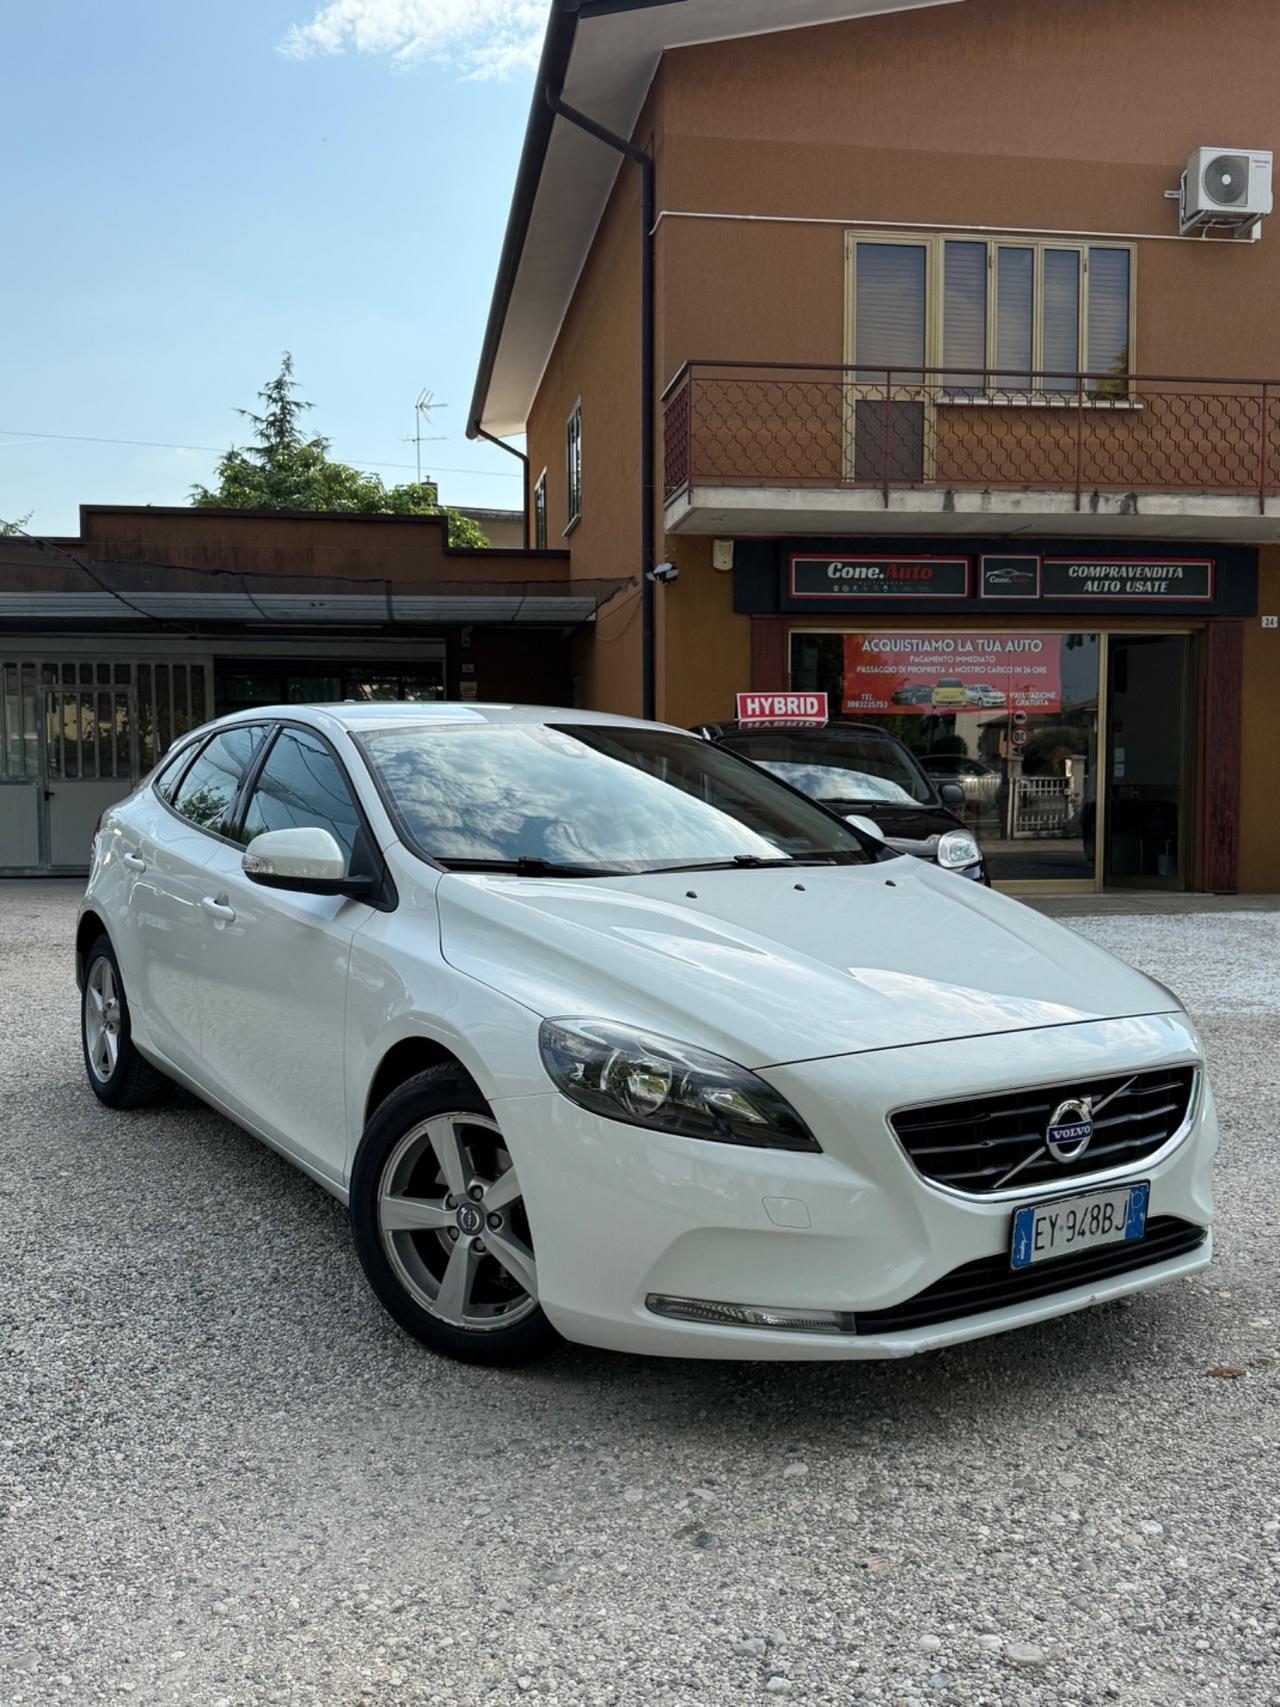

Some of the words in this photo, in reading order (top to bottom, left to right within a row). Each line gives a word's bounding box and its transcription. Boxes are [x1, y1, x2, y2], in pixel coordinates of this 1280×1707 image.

[1068, 565, 1183, 578] COMPRAVENDITA
[1083, 581, 1121, 592] AUTO
[1126, 581, 1168, 593] USATE
[862, 639, 955, 652] ACQUISTIAMO
[958, 639, 974, 652] LA
[976, 639, 1002, 652] TUA
[1005, 639, 1043, 652] AUTO
[909, 655, 953, 663] PAGAMENTO
[955, 655, 996, 663] IMMEDIATO
[856, 665, 897, 673] PASSAGGIO
[955, 665, 985, 673] NOSTRO
[987, 665, 1013, 673] CARICO
[1009, 691, 1056, 699] VALUTAZIONE
[746, 697, 819, 715] HYBRID
[1052, 1125, 1091, 1139] VOLVO
